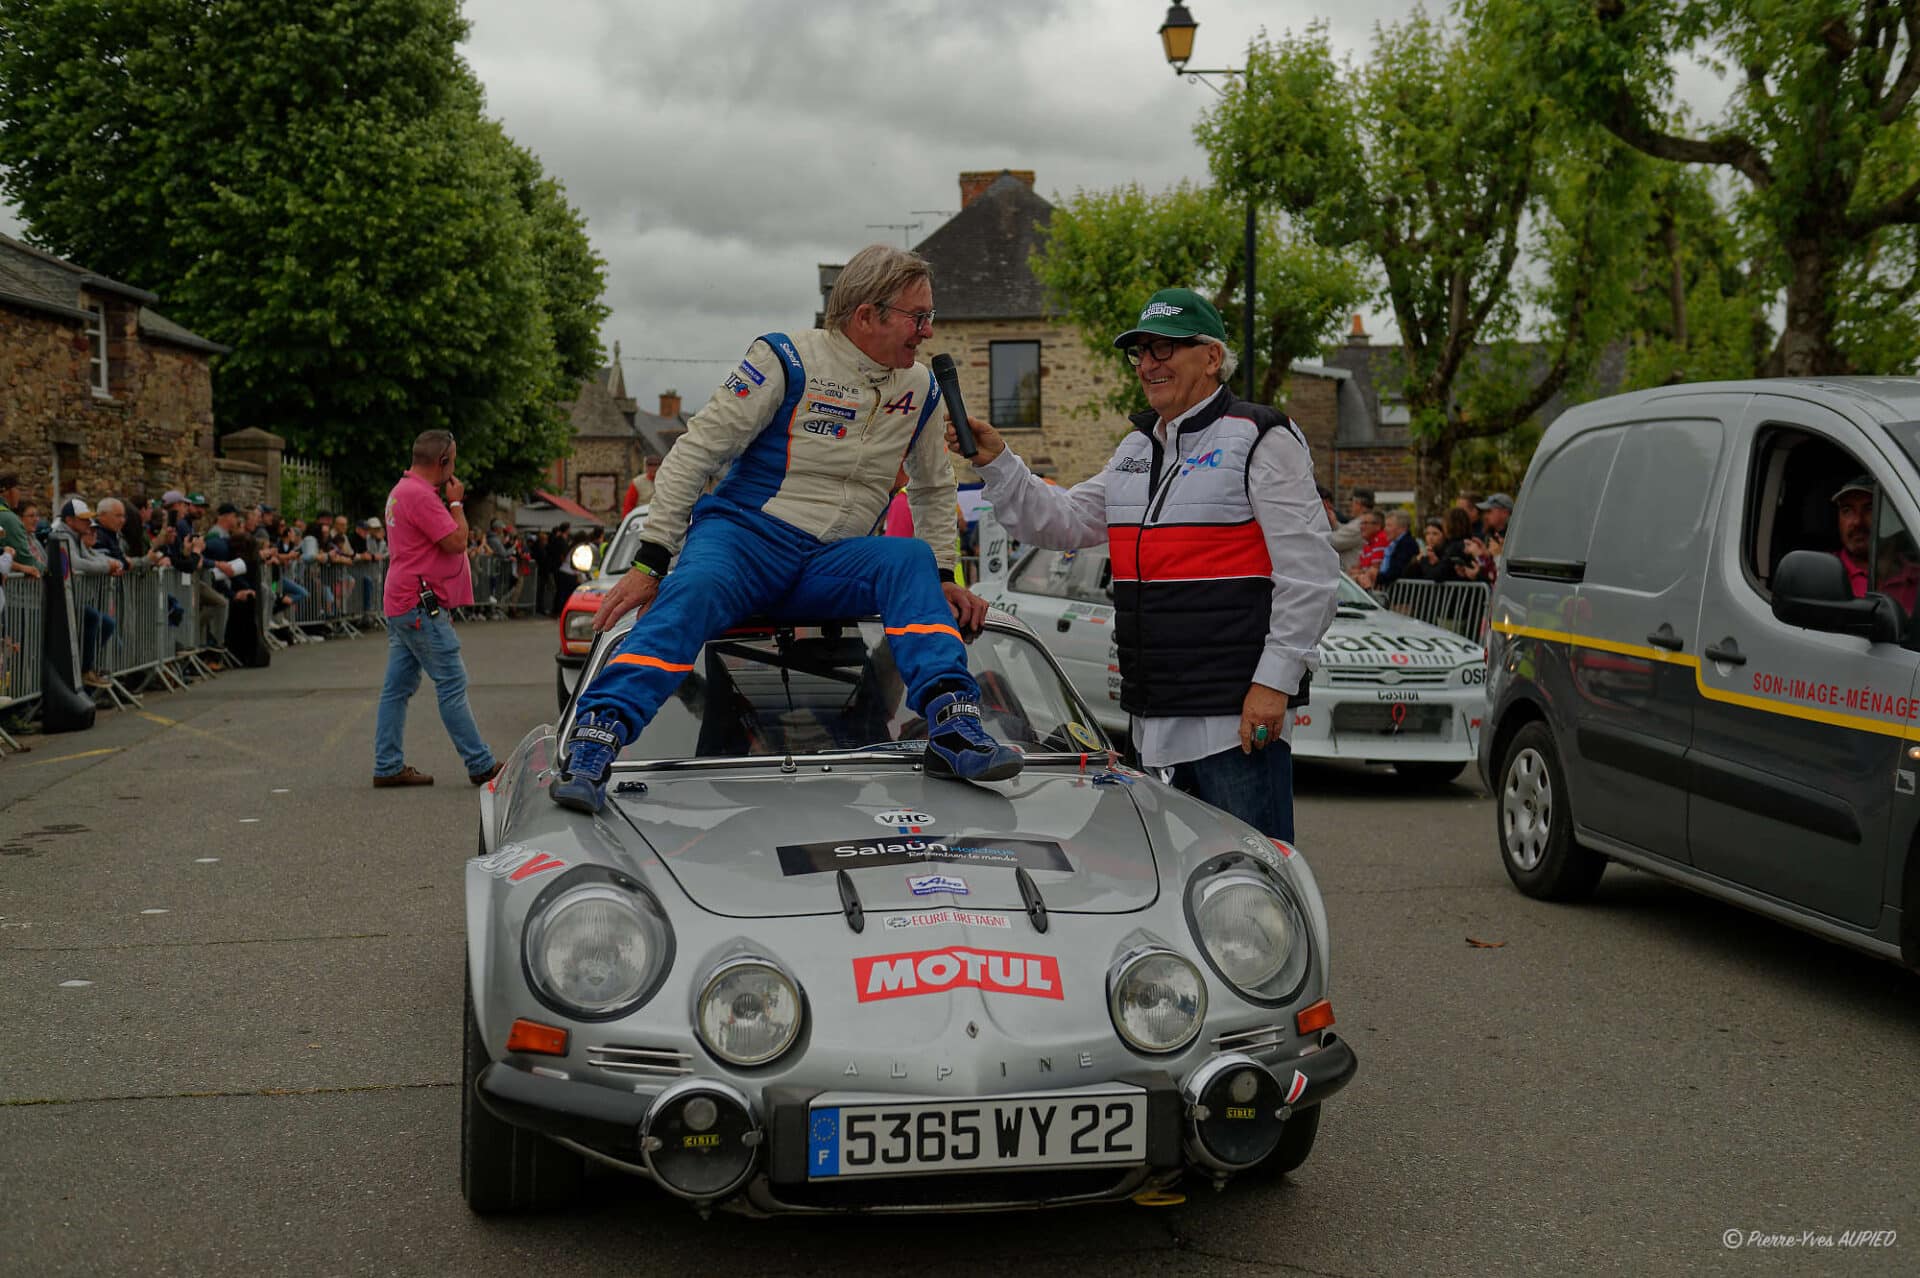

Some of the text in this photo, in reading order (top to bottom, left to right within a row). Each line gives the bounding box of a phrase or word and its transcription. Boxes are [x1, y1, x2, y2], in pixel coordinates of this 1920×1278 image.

[810, 378, 859, 394] ALPINE
[803, 421, 835, 435] elf
[880, 814, 929, 824] VHC
[834, 840, 947, 858] Salaün
[953, 911, 1007, 927] BRETAGNE
[866, 951, 1052, 994] MOTUL
[844, 1052, 1093, 1081] ALPINE
[846, 1102, 1134, 1166] 5365 WY 22
[818, 1150, 829, 1165] F
